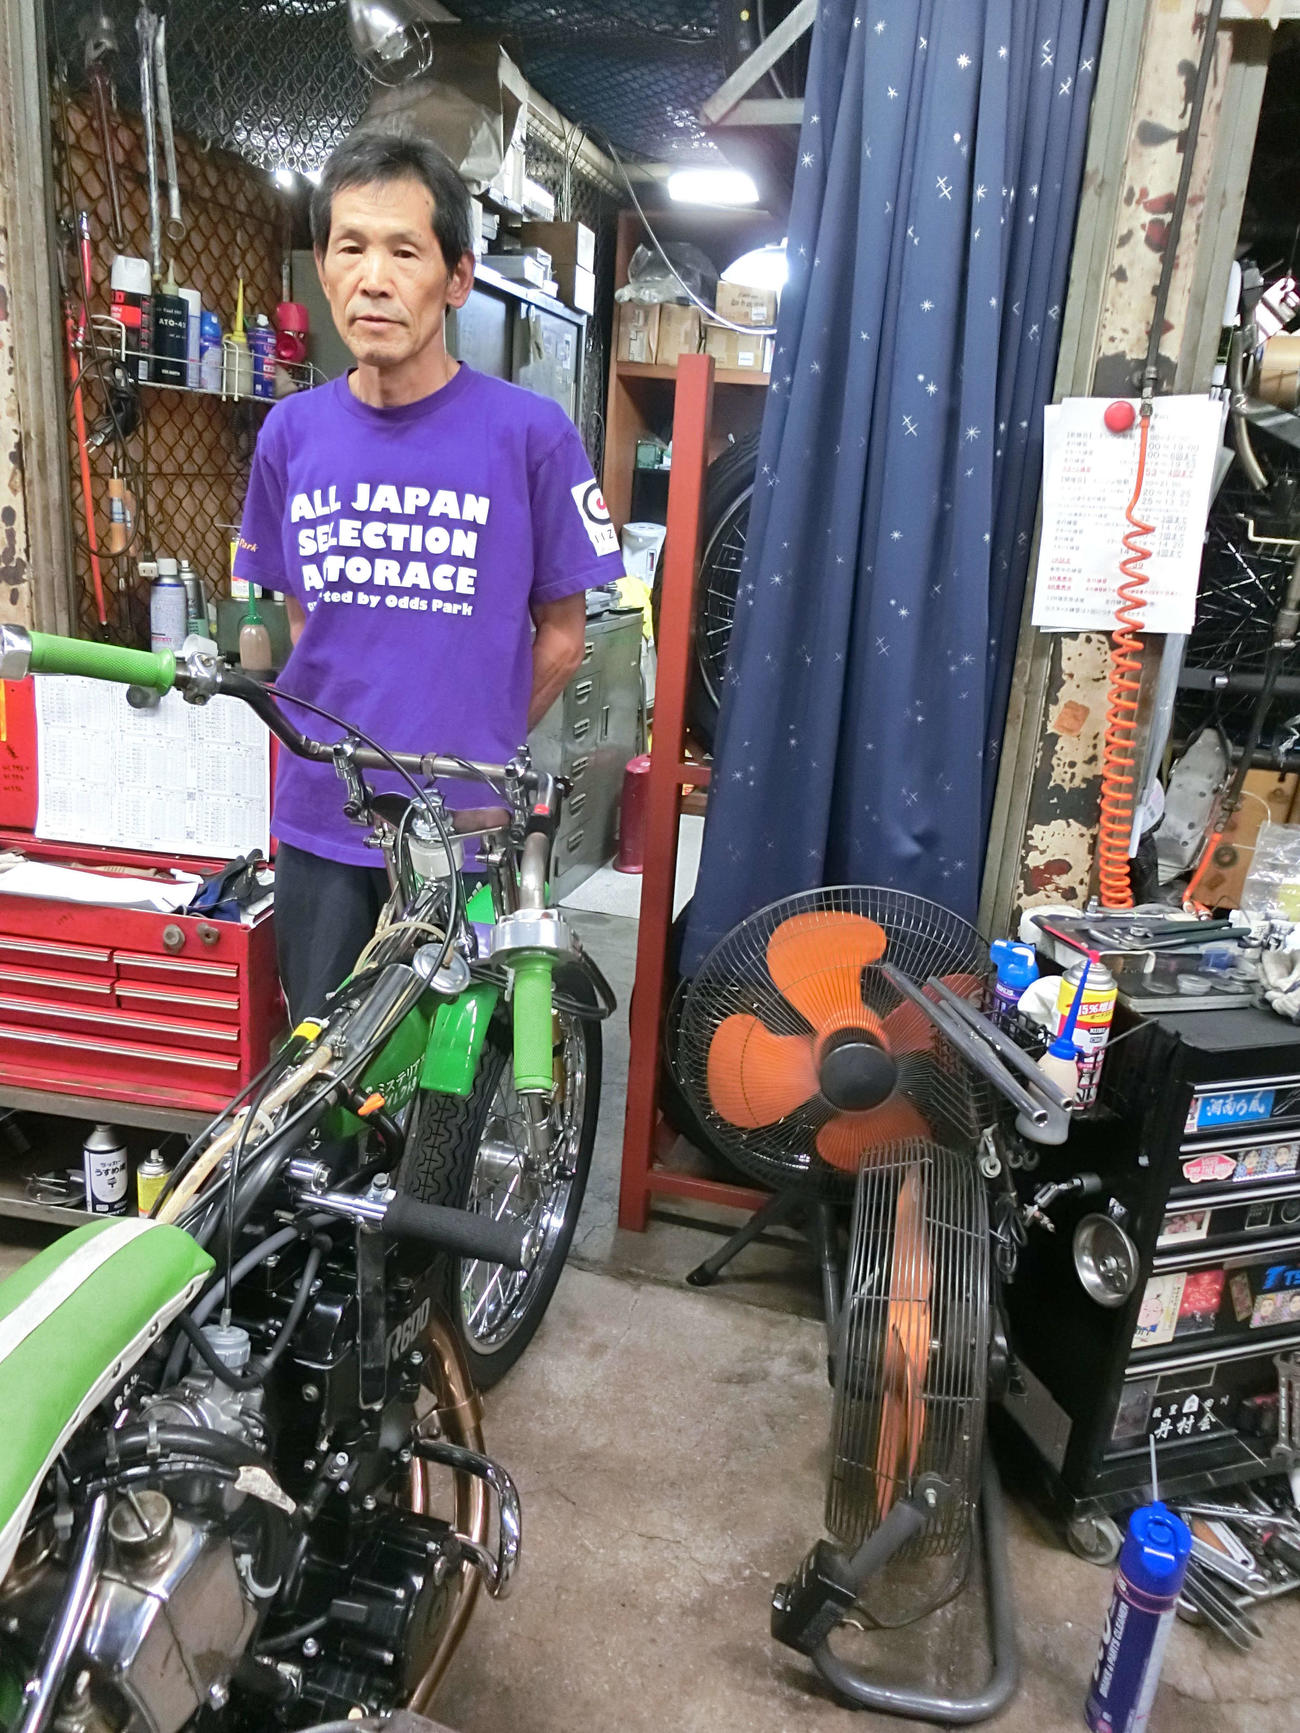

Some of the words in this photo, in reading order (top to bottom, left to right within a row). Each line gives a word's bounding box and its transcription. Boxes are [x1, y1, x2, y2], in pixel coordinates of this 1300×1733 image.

[291, 485, 341, 523] ALL
[351, 483, 490, 525] JAPAN
[298, 519, 478, 559] SELECTION
[302, 555, 478, 595] ATORACE
[357, 592, 381, 608] by
[384, 594, 428, 611] Odds
[431, 599, 474, 616] Park
